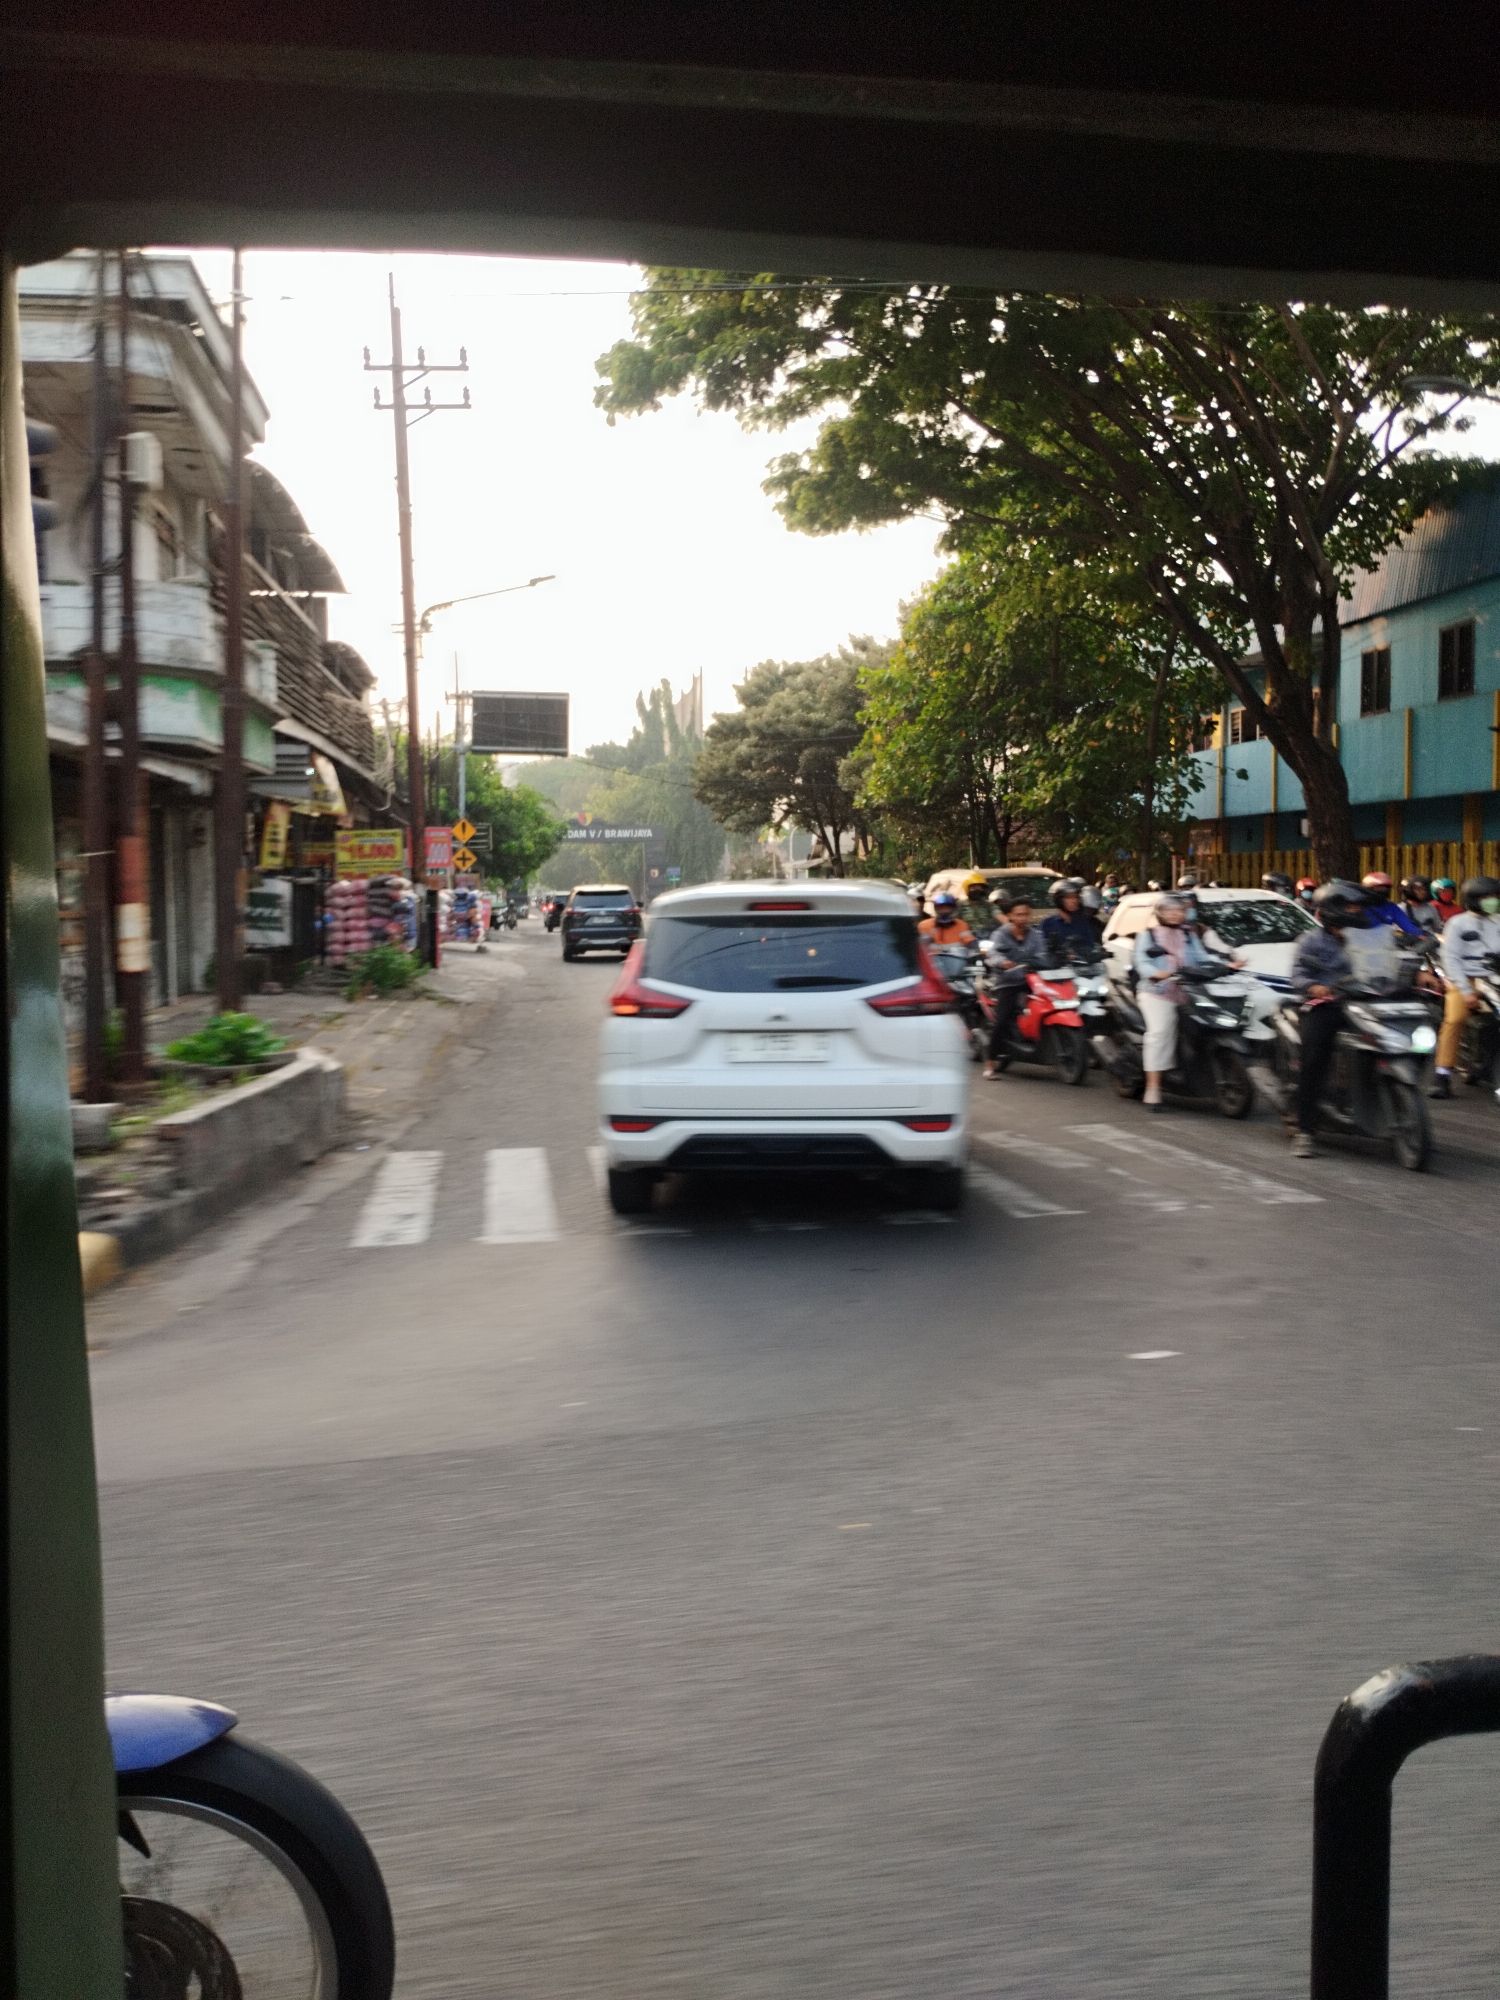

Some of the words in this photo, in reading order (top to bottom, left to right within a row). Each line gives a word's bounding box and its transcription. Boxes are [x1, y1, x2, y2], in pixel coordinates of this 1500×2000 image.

[558, 829, 587, 839] DAM
[588, 829, 596, 839] V
[604, 828, 653, 839] BRAWIJAYA
